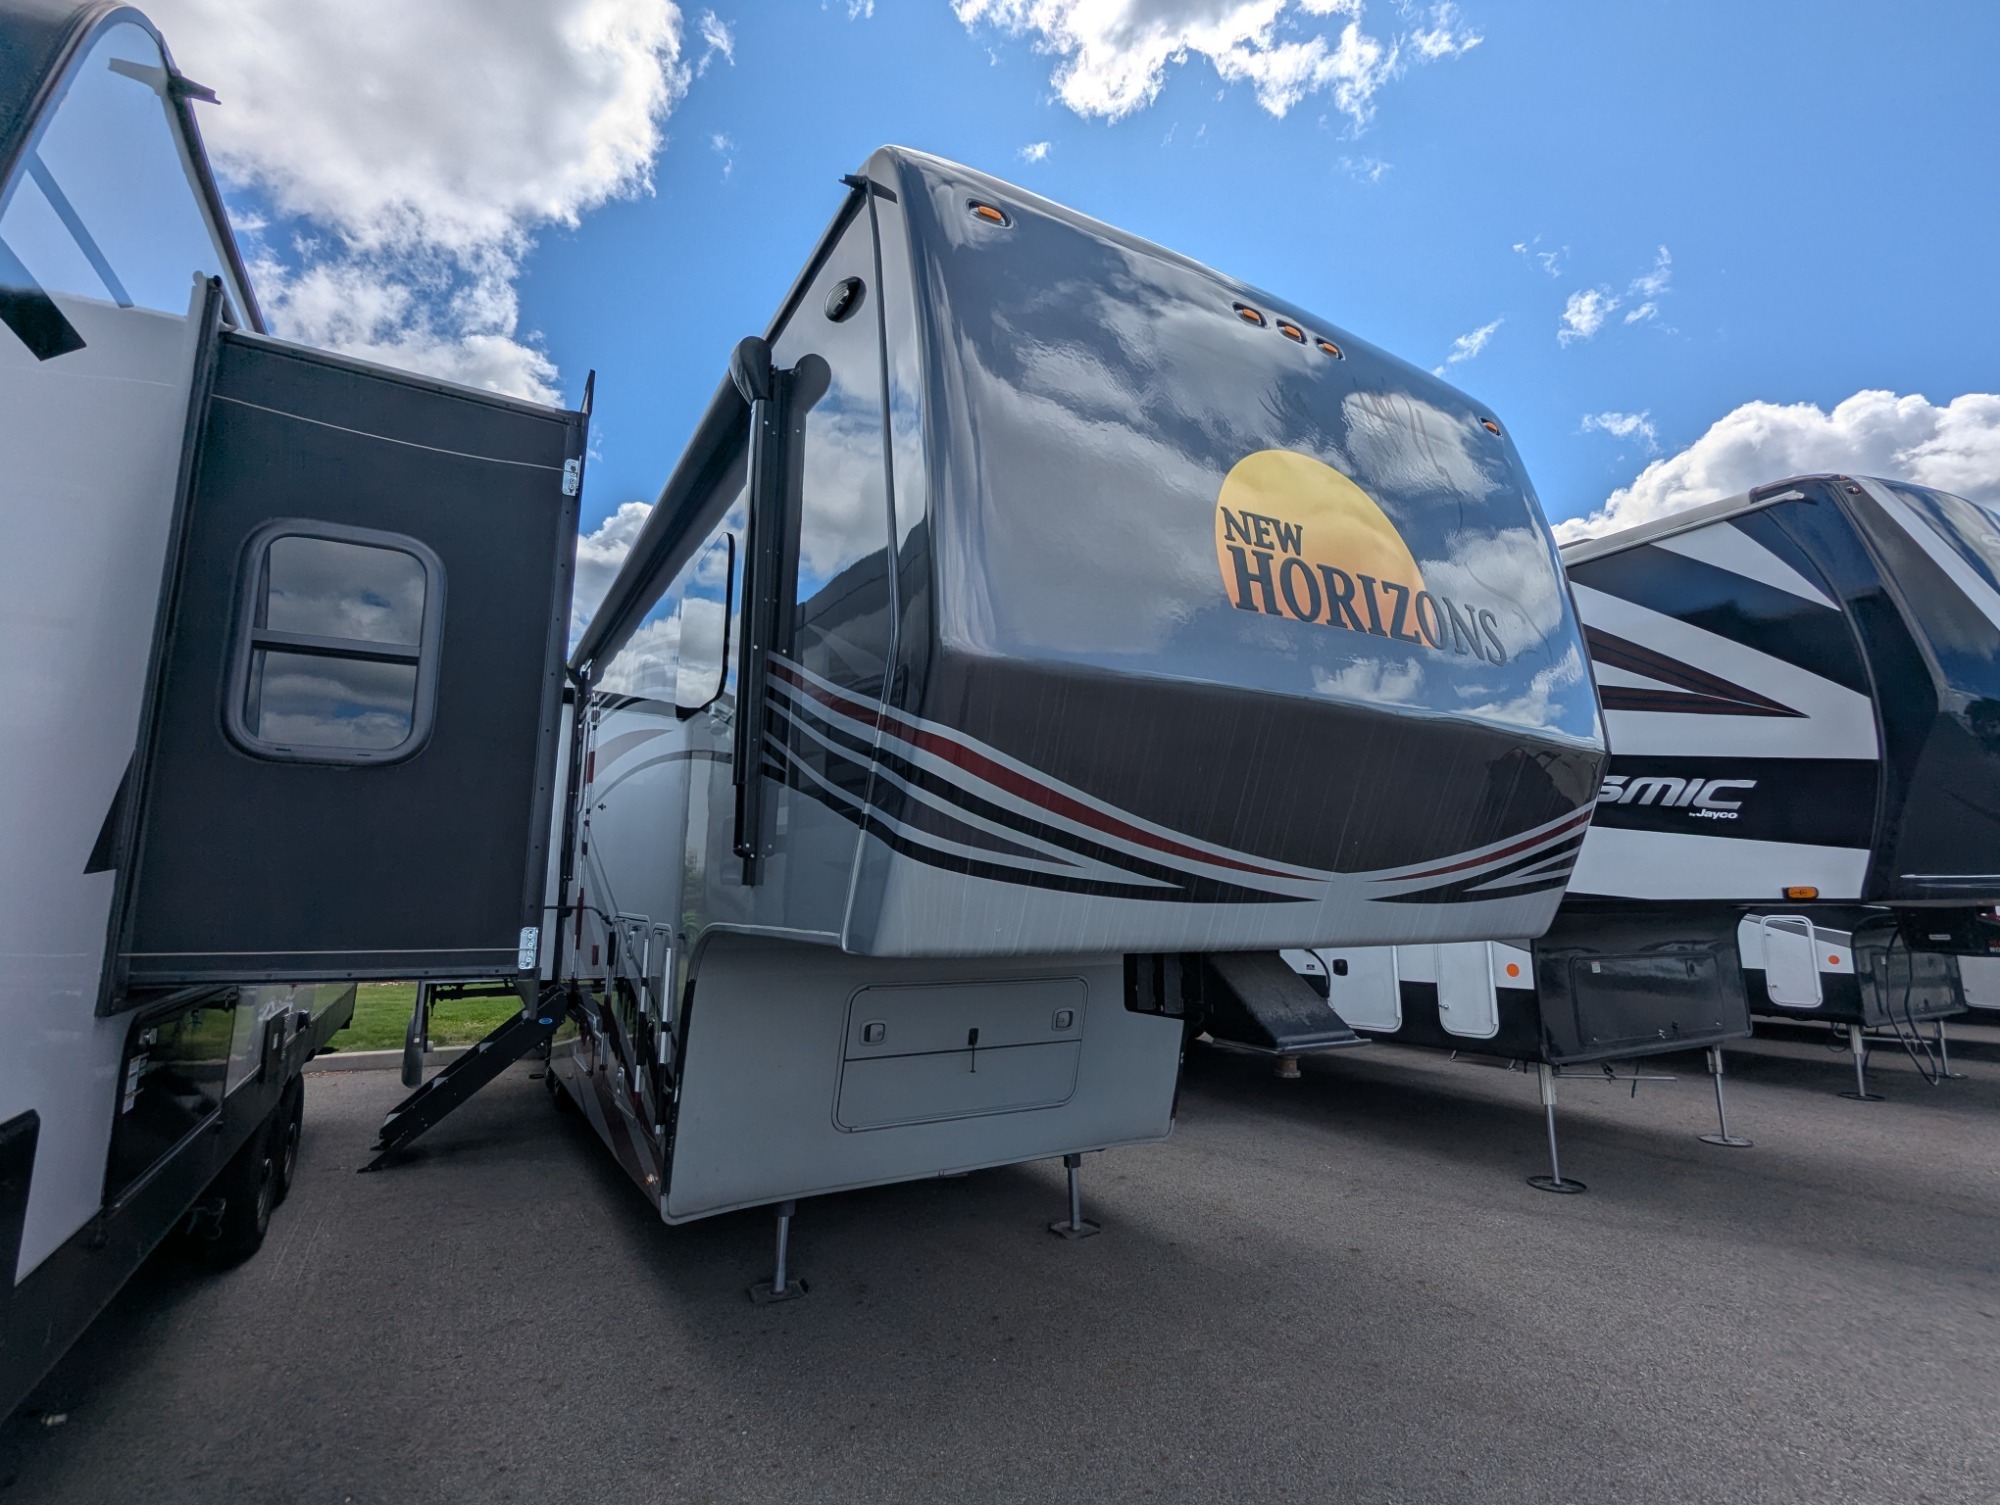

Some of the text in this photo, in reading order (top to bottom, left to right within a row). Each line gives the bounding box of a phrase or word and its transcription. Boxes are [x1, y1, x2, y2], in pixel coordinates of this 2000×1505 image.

[1220, 506, 1304, 556] NEW
[1226, 545, 1508, 667] HORIZONS
[1696, 808, 1738, 820] Jayco
